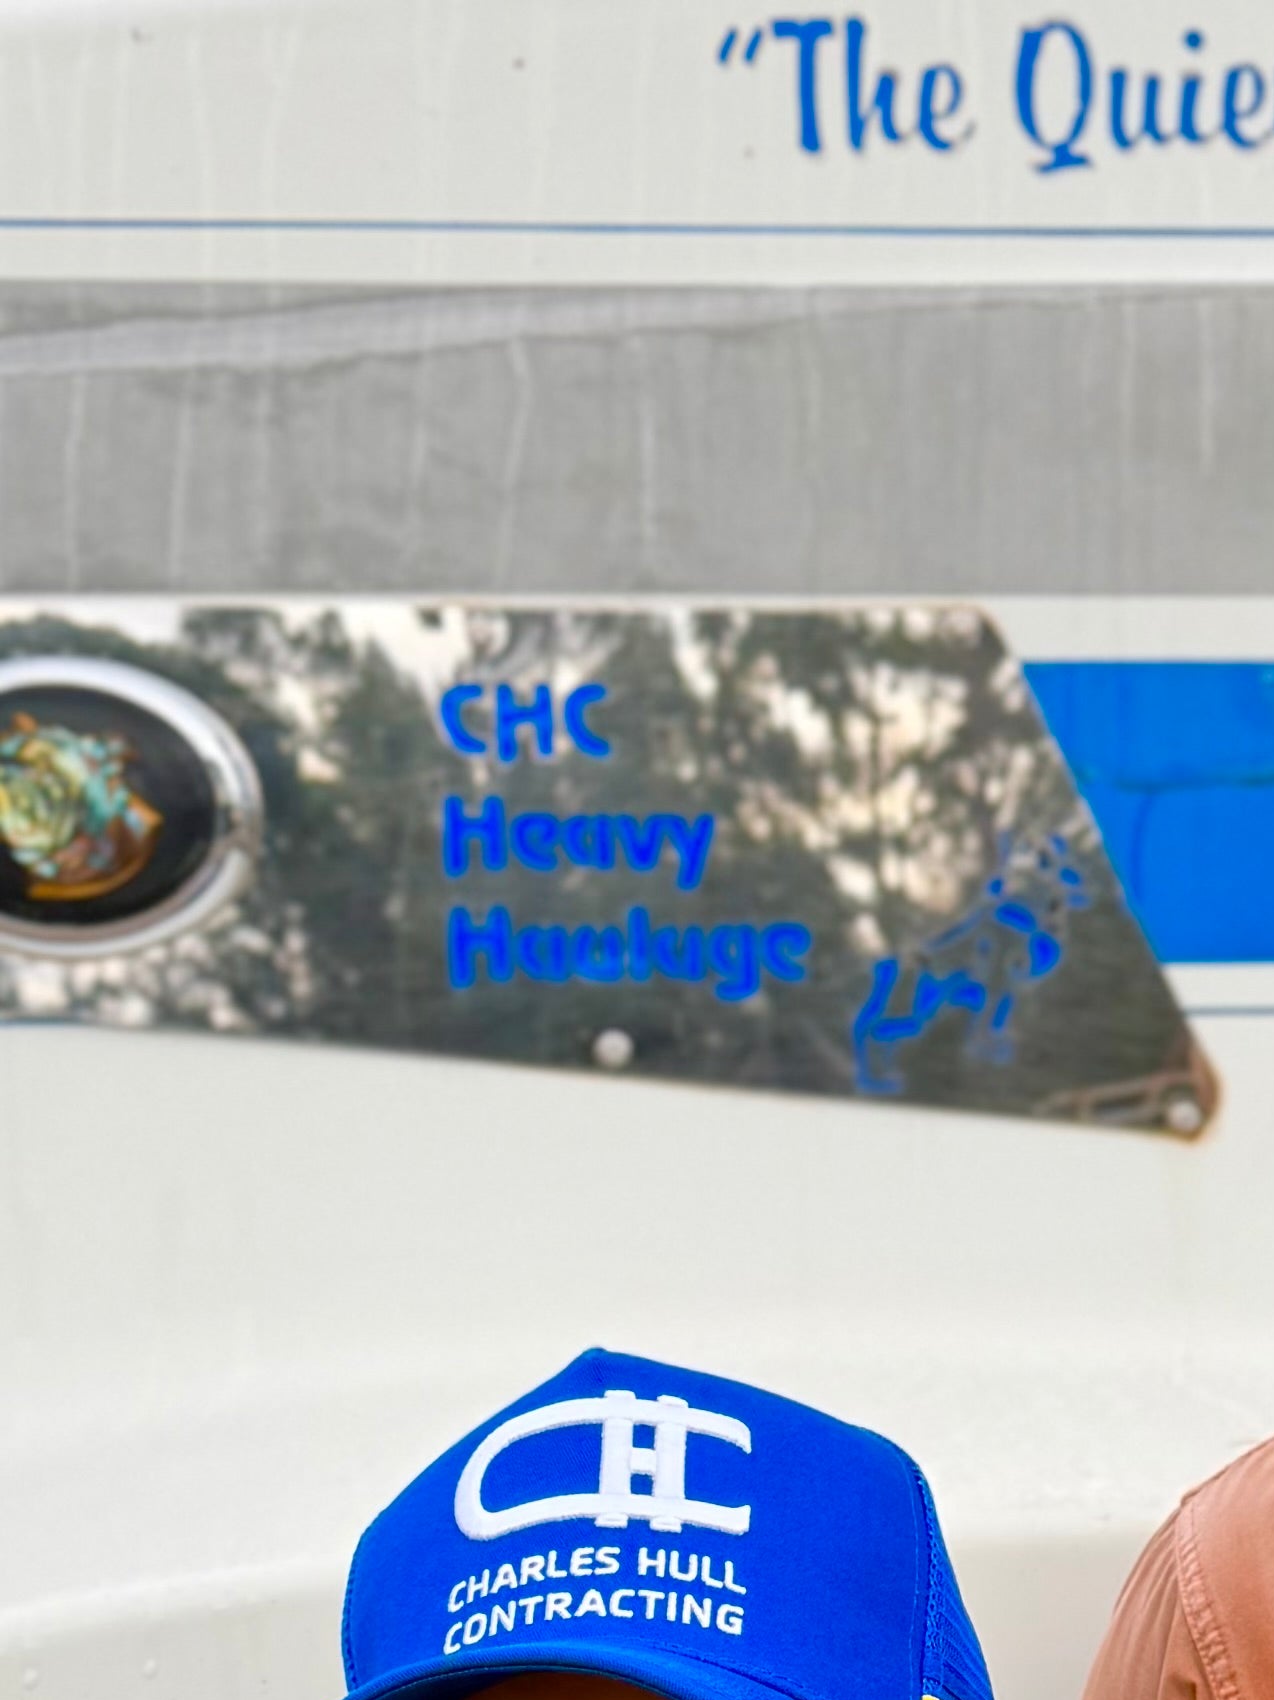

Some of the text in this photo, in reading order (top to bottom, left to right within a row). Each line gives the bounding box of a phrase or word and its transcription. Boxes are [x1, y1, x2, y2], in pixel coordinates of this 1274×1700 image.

[440, 683, 611, 763] CHC
[443, 794, 715, 891] Heavy
[447, 904, 812, 1003] Haulage
[447, 1546, 747, 1613] CHARLES HULL
[443, 1588, 746, 1655] CONTRACTING
